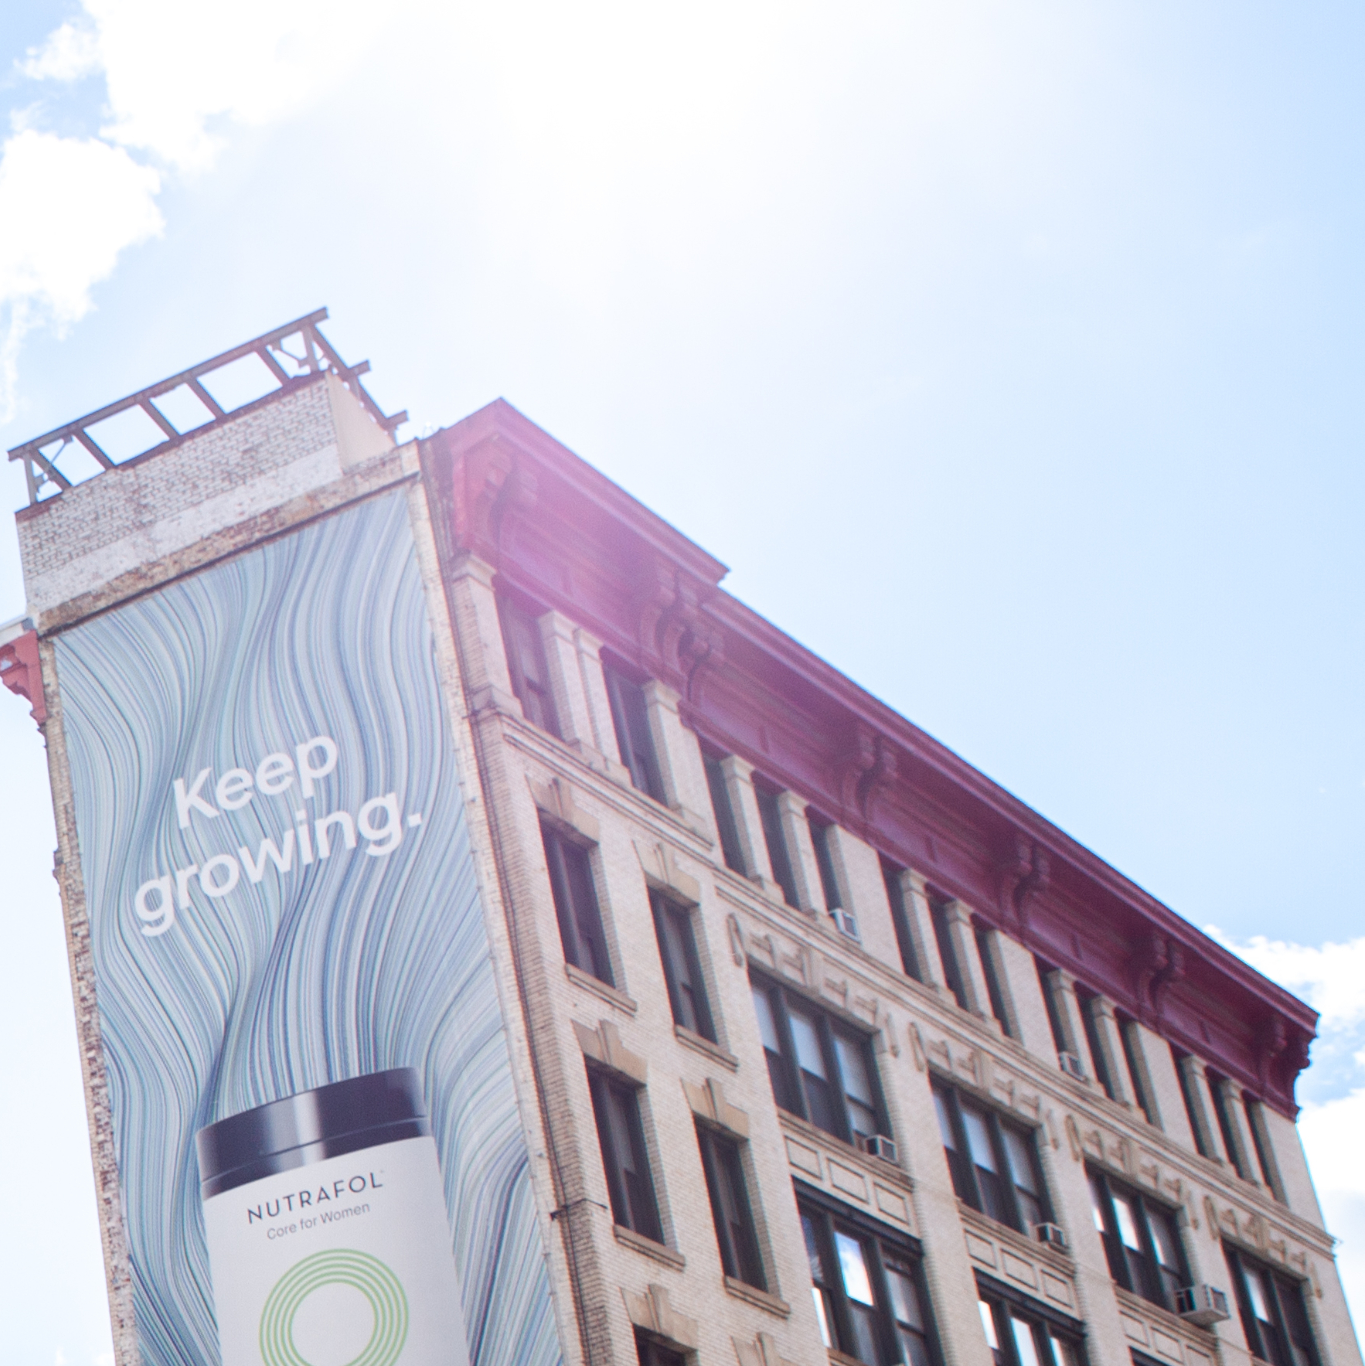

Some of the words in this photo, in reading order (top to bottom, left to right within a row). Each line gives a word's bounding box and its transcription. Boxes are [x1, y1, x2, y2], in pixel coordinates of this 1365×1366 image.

[173, 735, 337, 829] Keep
[134, 792, 422, 937] growing.
[247, 1172, 383, 1224] NUTRAFOL
[267, 1223, 297, 1240] Core
[300, 1216, 317, 1230] for
[320, 1203, 371, 1224] Women
